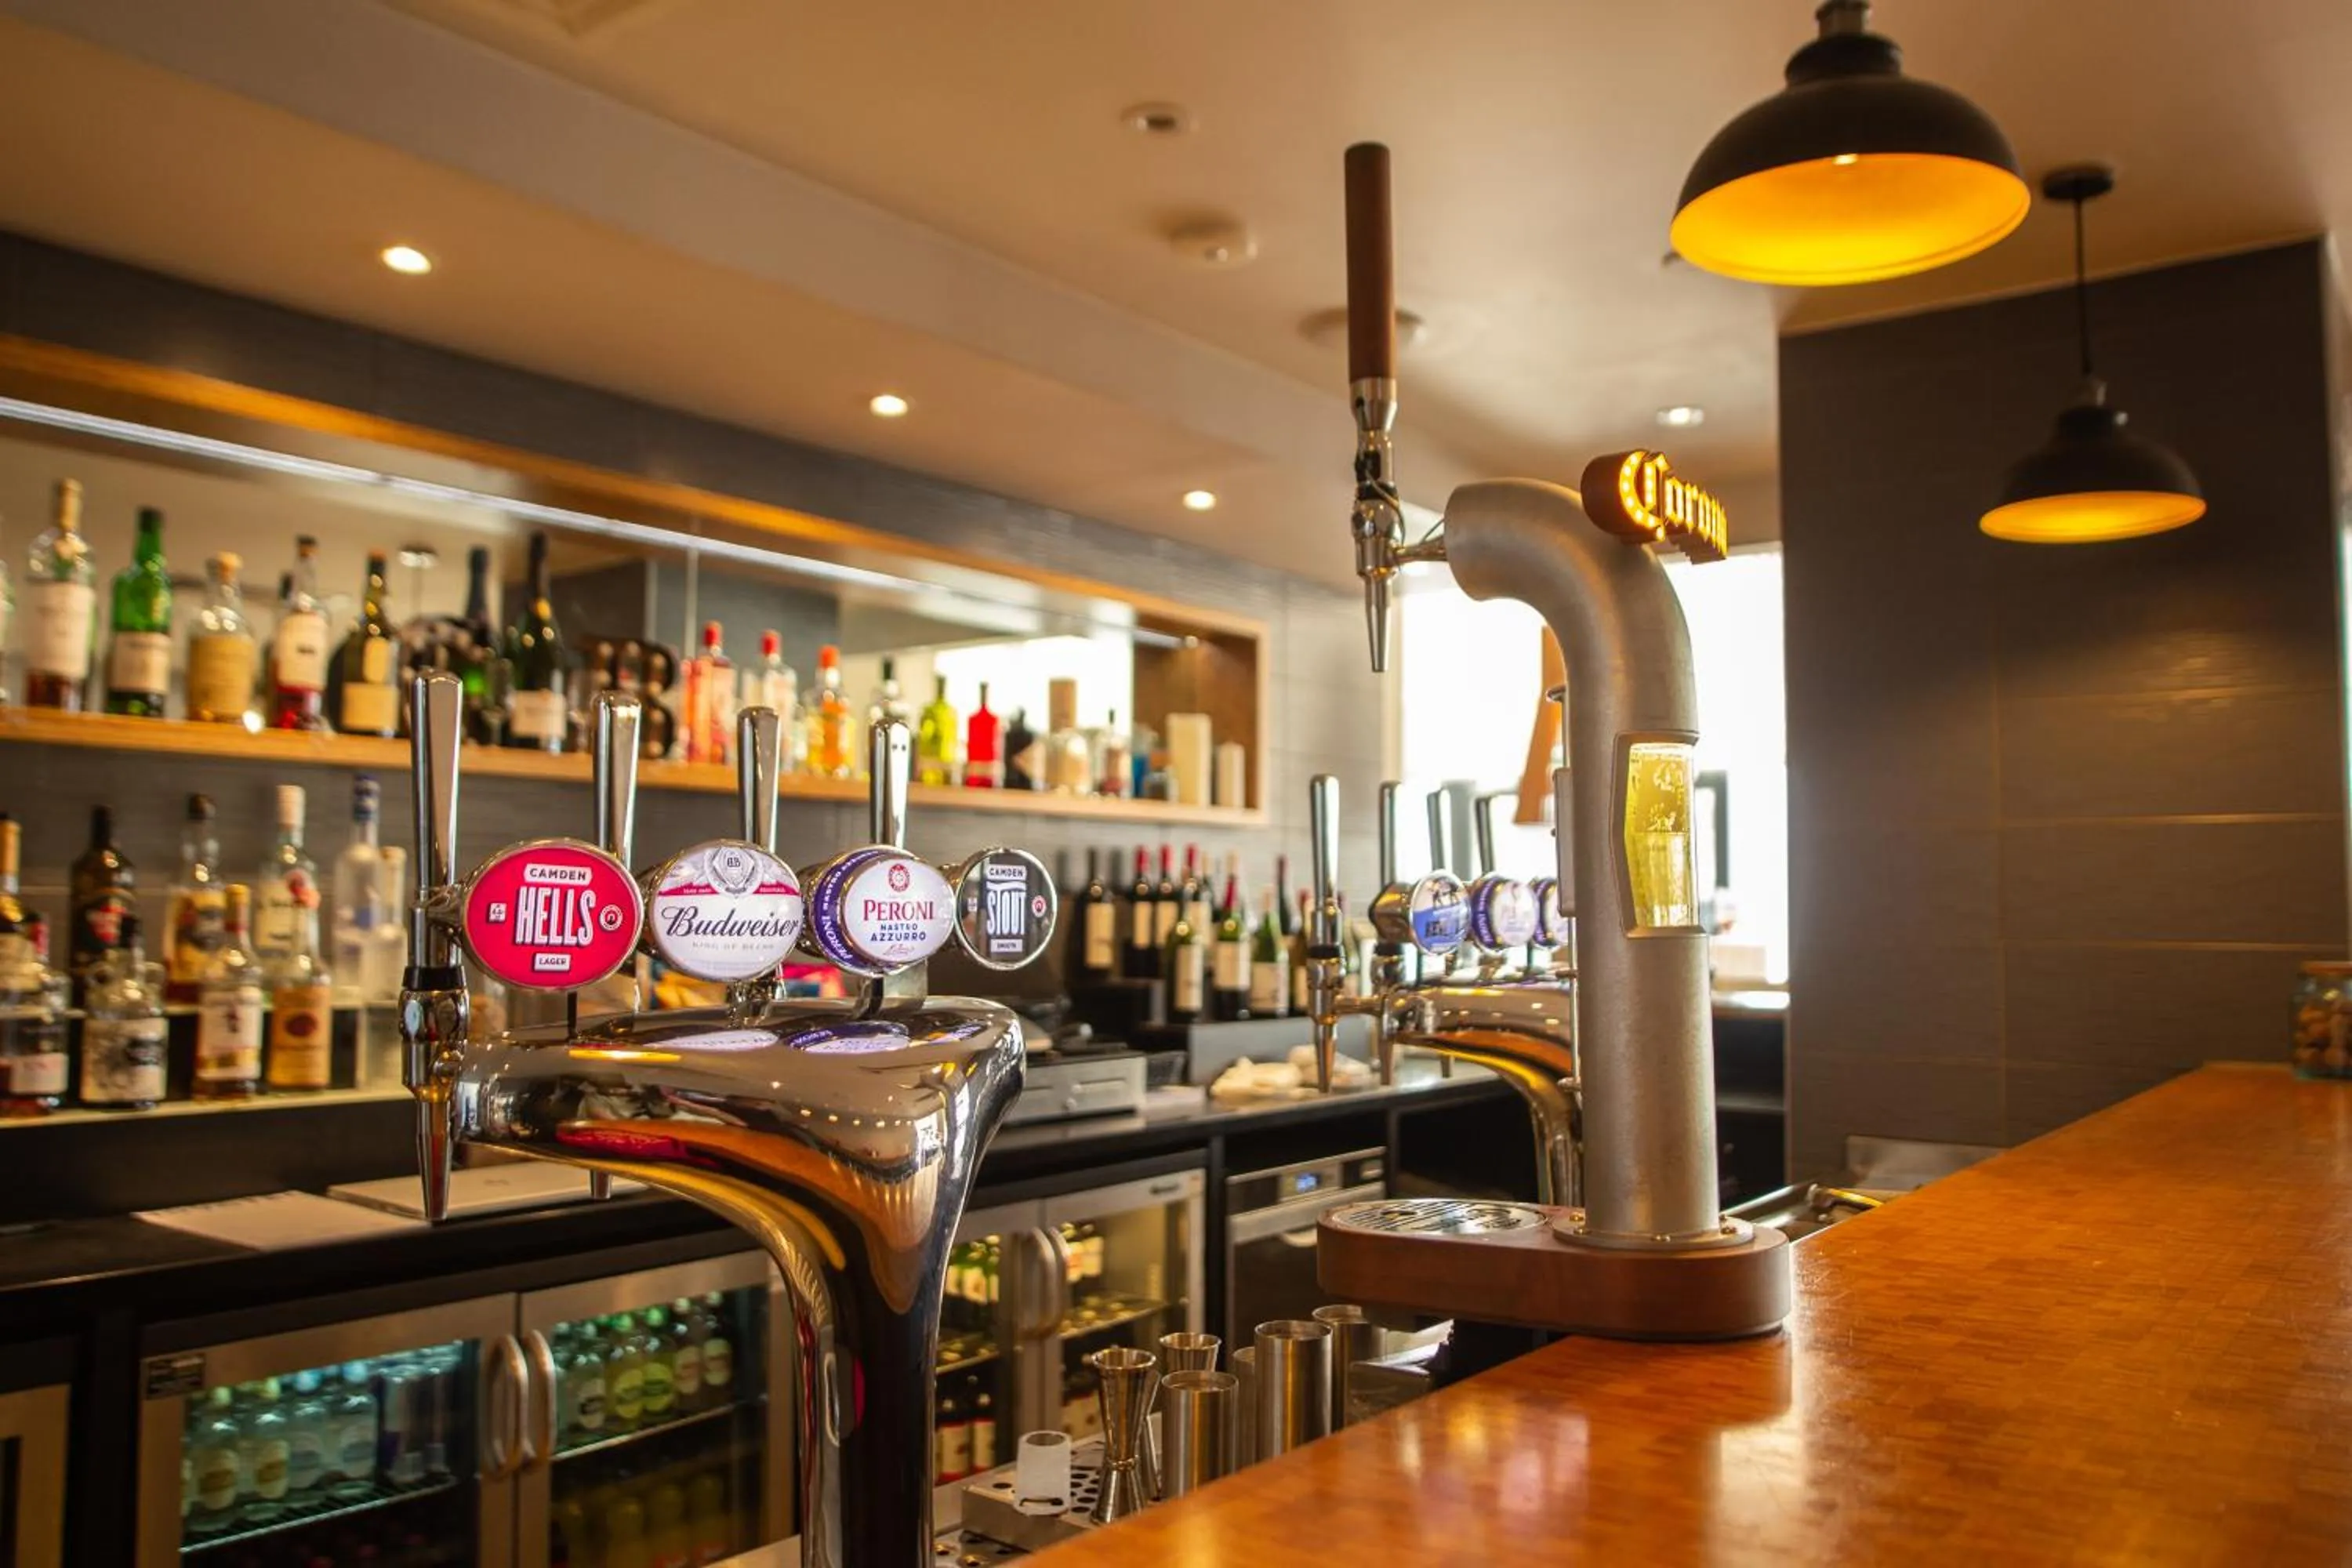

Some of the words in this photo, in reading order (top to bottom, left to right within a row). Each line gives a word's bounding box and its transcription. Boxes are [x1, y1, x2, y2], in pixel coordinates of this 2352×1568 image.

[529, 868, 587, 881] CAMDEN
[989, 868, 1023, 877] CAMDEN
[515, 886, 597, 946] HELLS
[863, 899, 934, 921] PERONI
[986, 880, 1026, 935] STOUT
[661, 906, 799, 937] Budweiser
[870, 931, 927, 942] AZZURRO
[539, 957, 567, 966] LAGER
